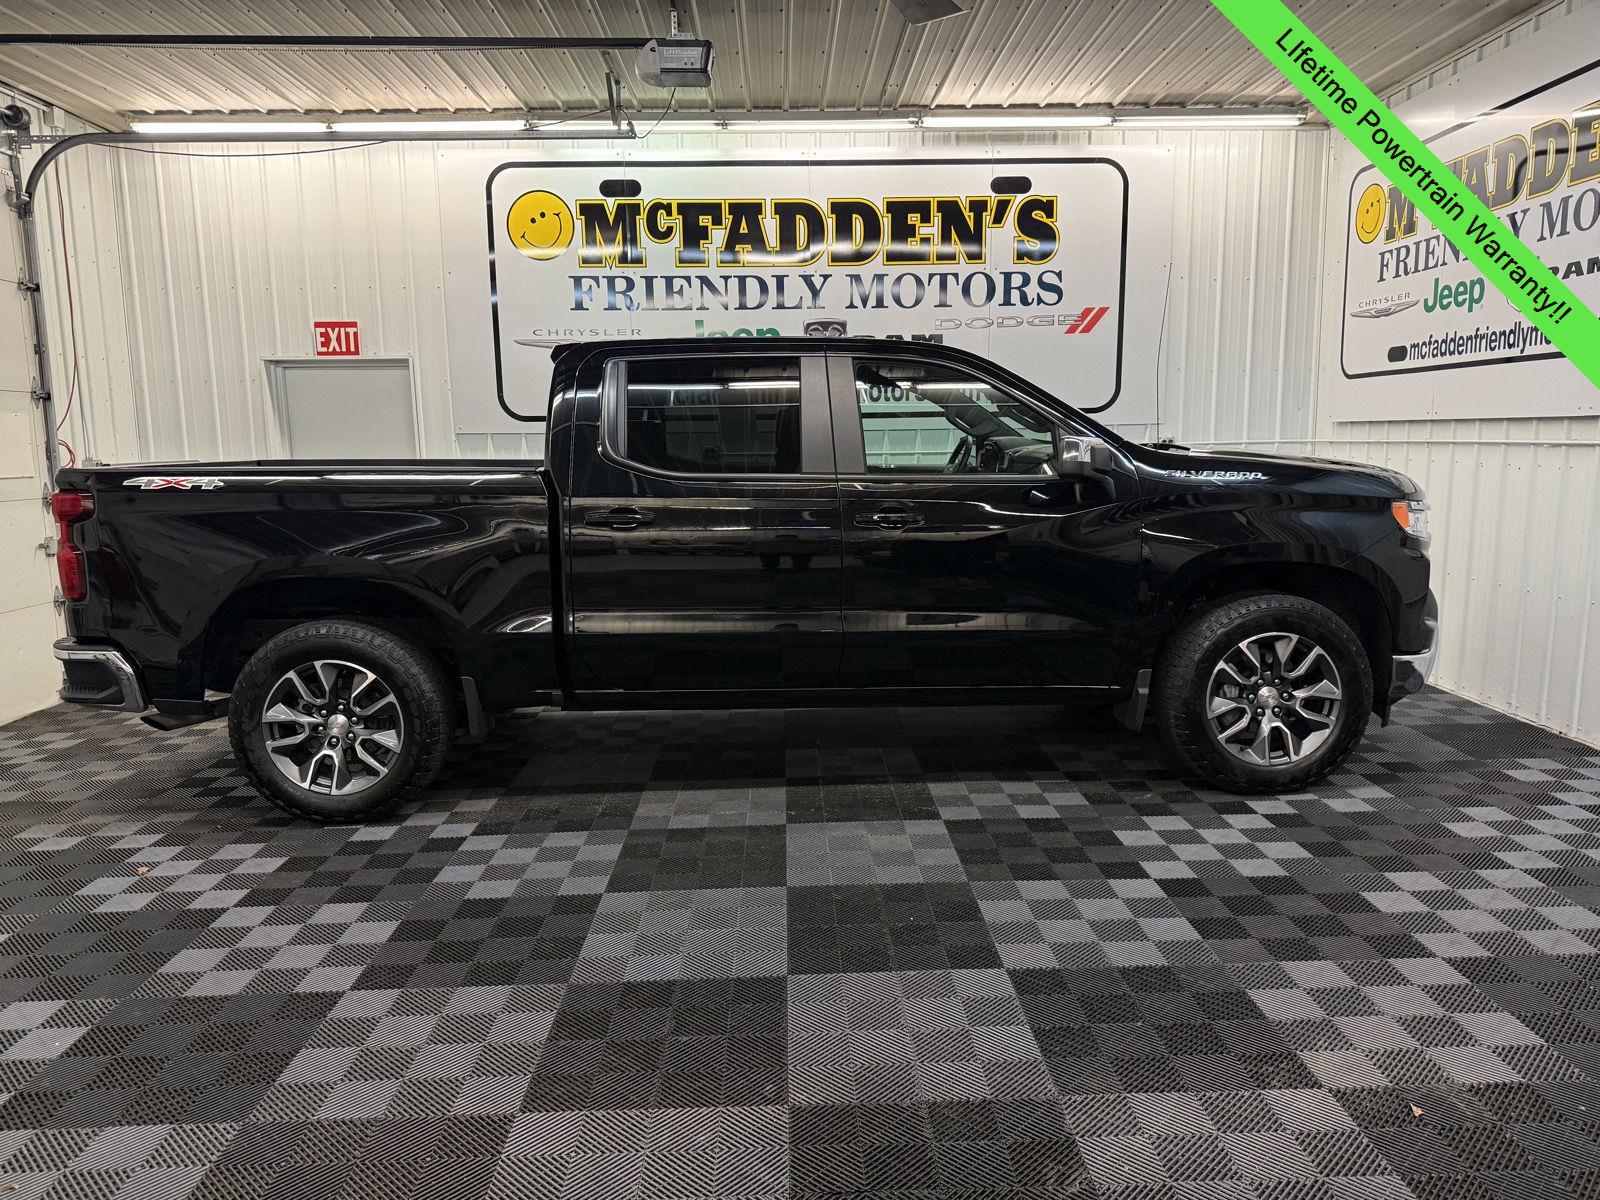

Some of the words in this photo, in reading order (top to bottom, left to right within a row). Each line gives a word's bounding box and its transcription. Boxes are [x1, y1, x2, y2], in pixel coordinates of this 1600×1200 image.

[568, 274, 833, 311] FRIENDLY
[845, 270, 1064, 310] MOTORS
[1358, 292, 1411, 308] CHRYSLER
[1424, 277, 1485, 313] Jeep
[934, 314, 1083, 330] DODGE
[315, 327, 358, 352] EXIT
[532, 328, 641, 337] CHRYSLER
